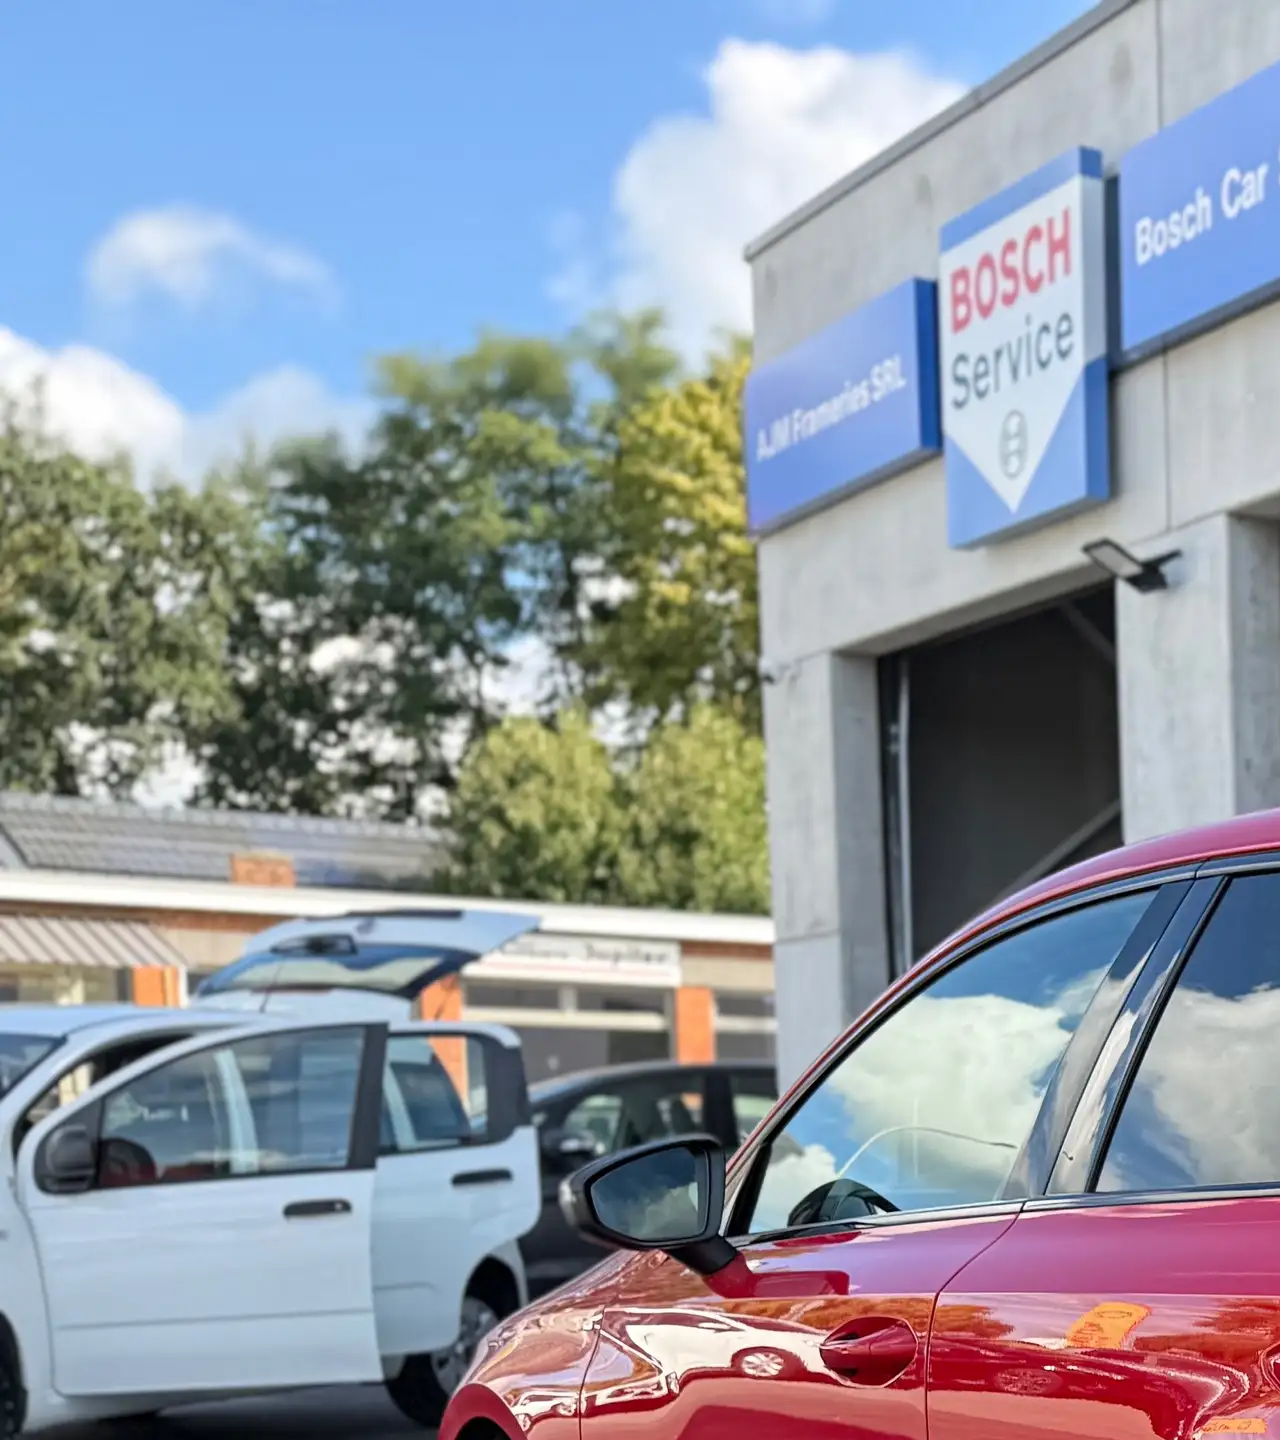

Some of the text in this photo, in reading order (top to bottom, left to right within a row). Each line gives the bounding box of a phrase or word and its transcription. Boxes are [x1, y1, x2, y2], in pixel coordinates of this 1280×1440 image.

[1135, 187, 1212, 266] Bosch
[1220, 163, 1269, 219] Car
[951, 206, 1072, 335] BOSCH
[951, 312, 1074, 410] Service
